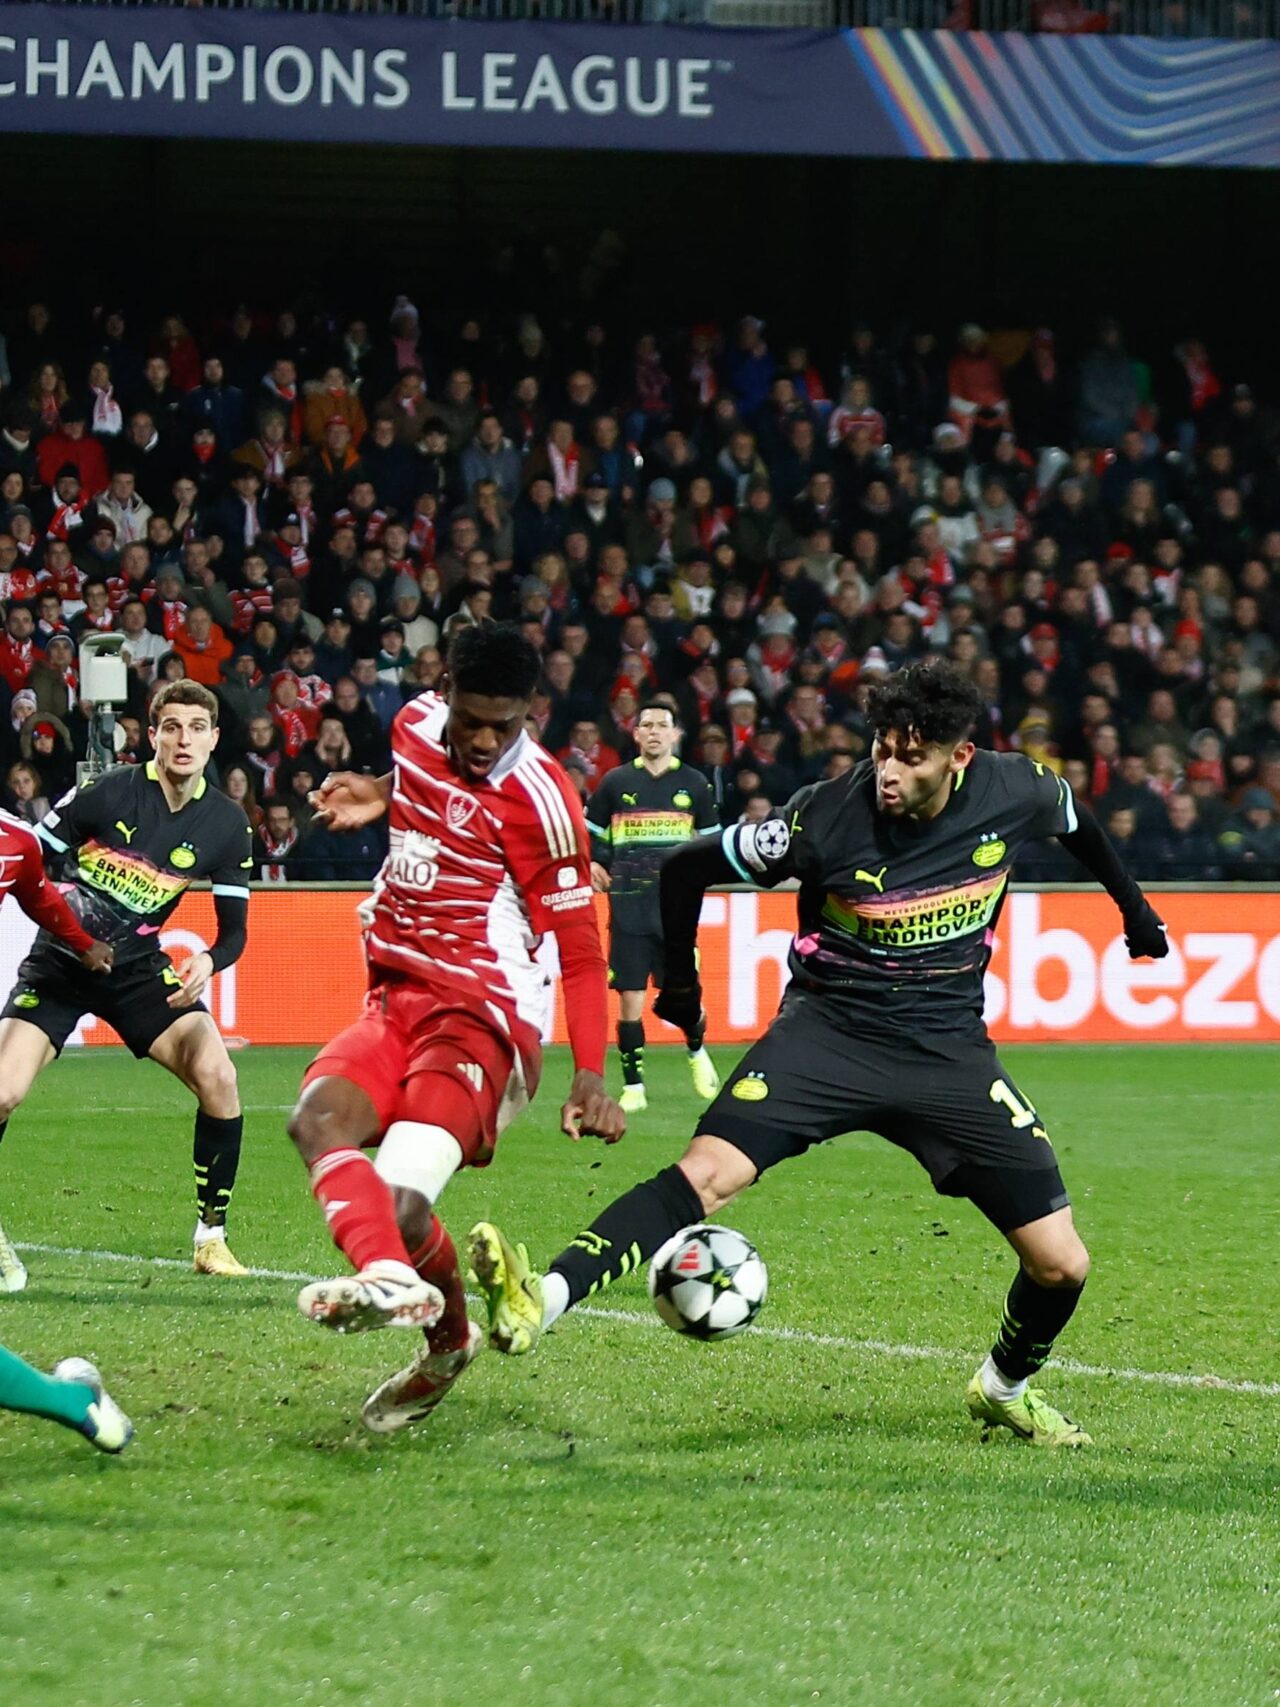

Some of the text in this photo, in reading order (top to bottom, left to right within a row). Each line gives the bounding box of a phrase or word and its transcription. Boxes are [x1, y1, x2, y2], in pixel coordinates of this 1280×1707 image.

[92, 870, 158, 908] EINHVE
[884, 893, 971, 916] METROPOOLREGIO
[989, 1079, 1037, 1129] 1
